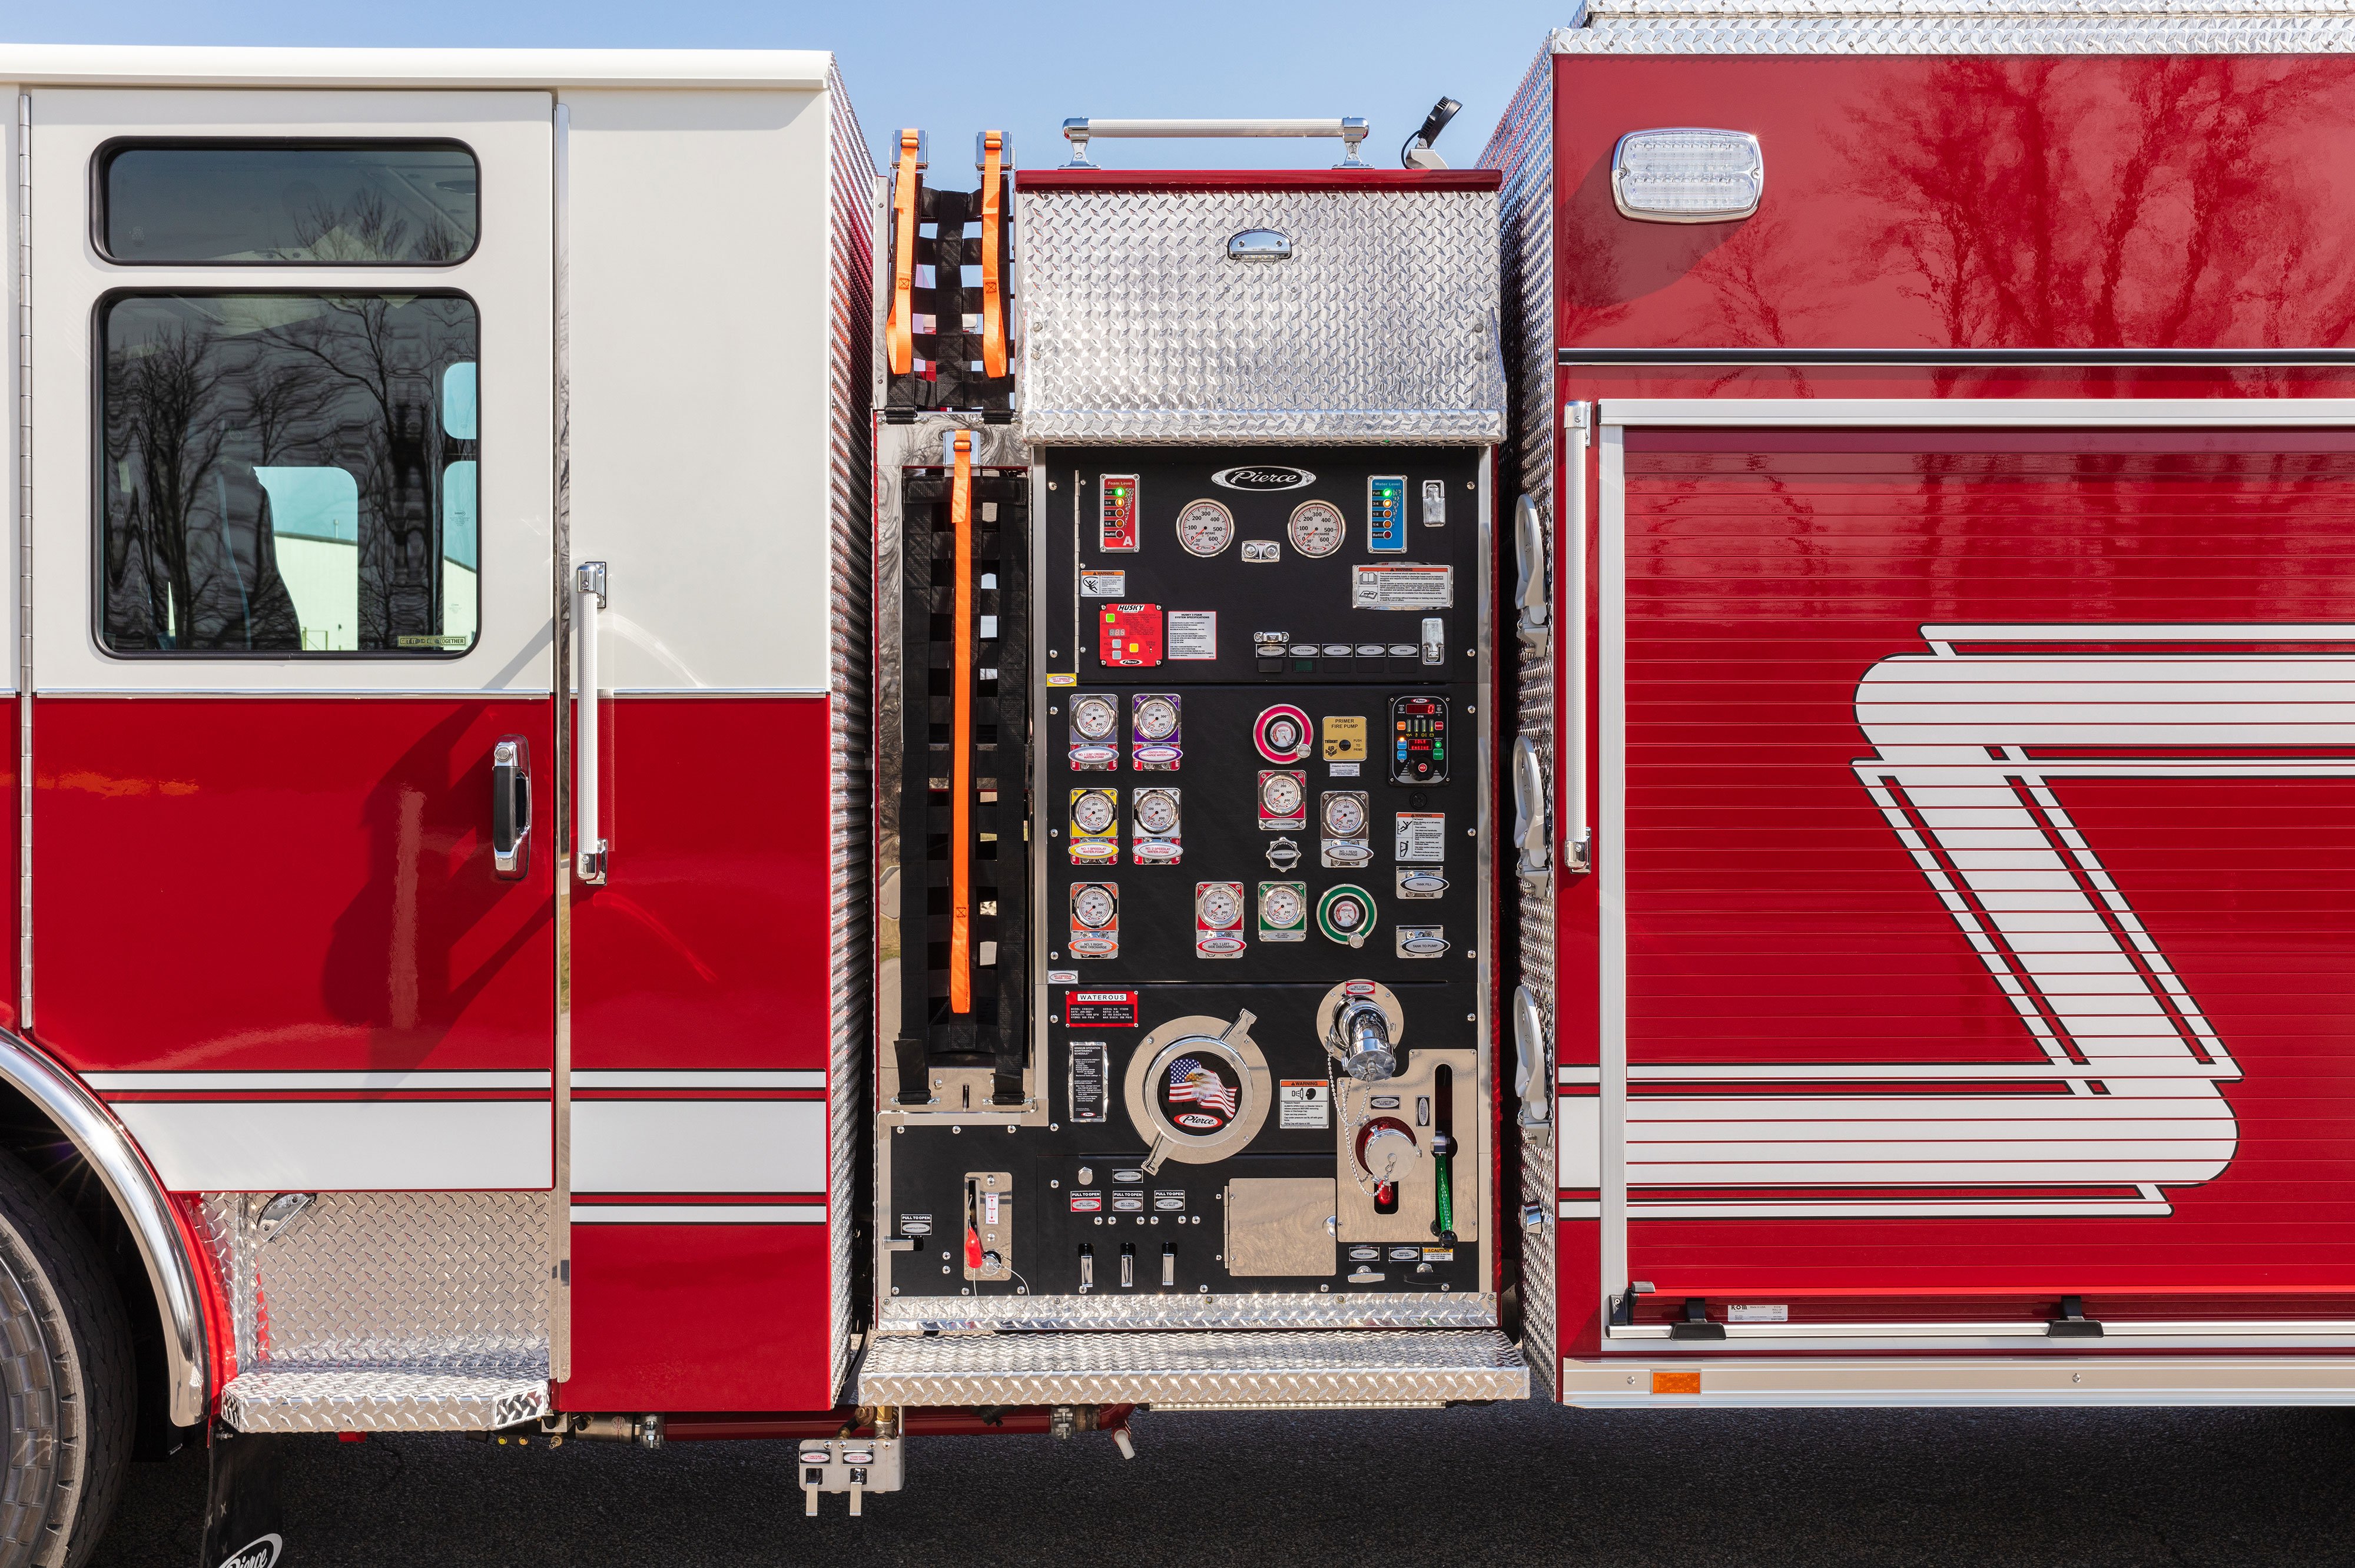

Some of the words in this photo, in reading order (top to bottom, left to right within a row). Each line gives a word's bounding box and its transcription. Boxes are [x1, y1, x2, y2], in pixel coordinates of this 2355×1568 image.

[1230, 470, 1298, 483] Pierce
[1123, 536, 1133, 546] A
[1428, 705, 1434, 714] 0
[1183, 1115, 1213, 1125] Pierce
